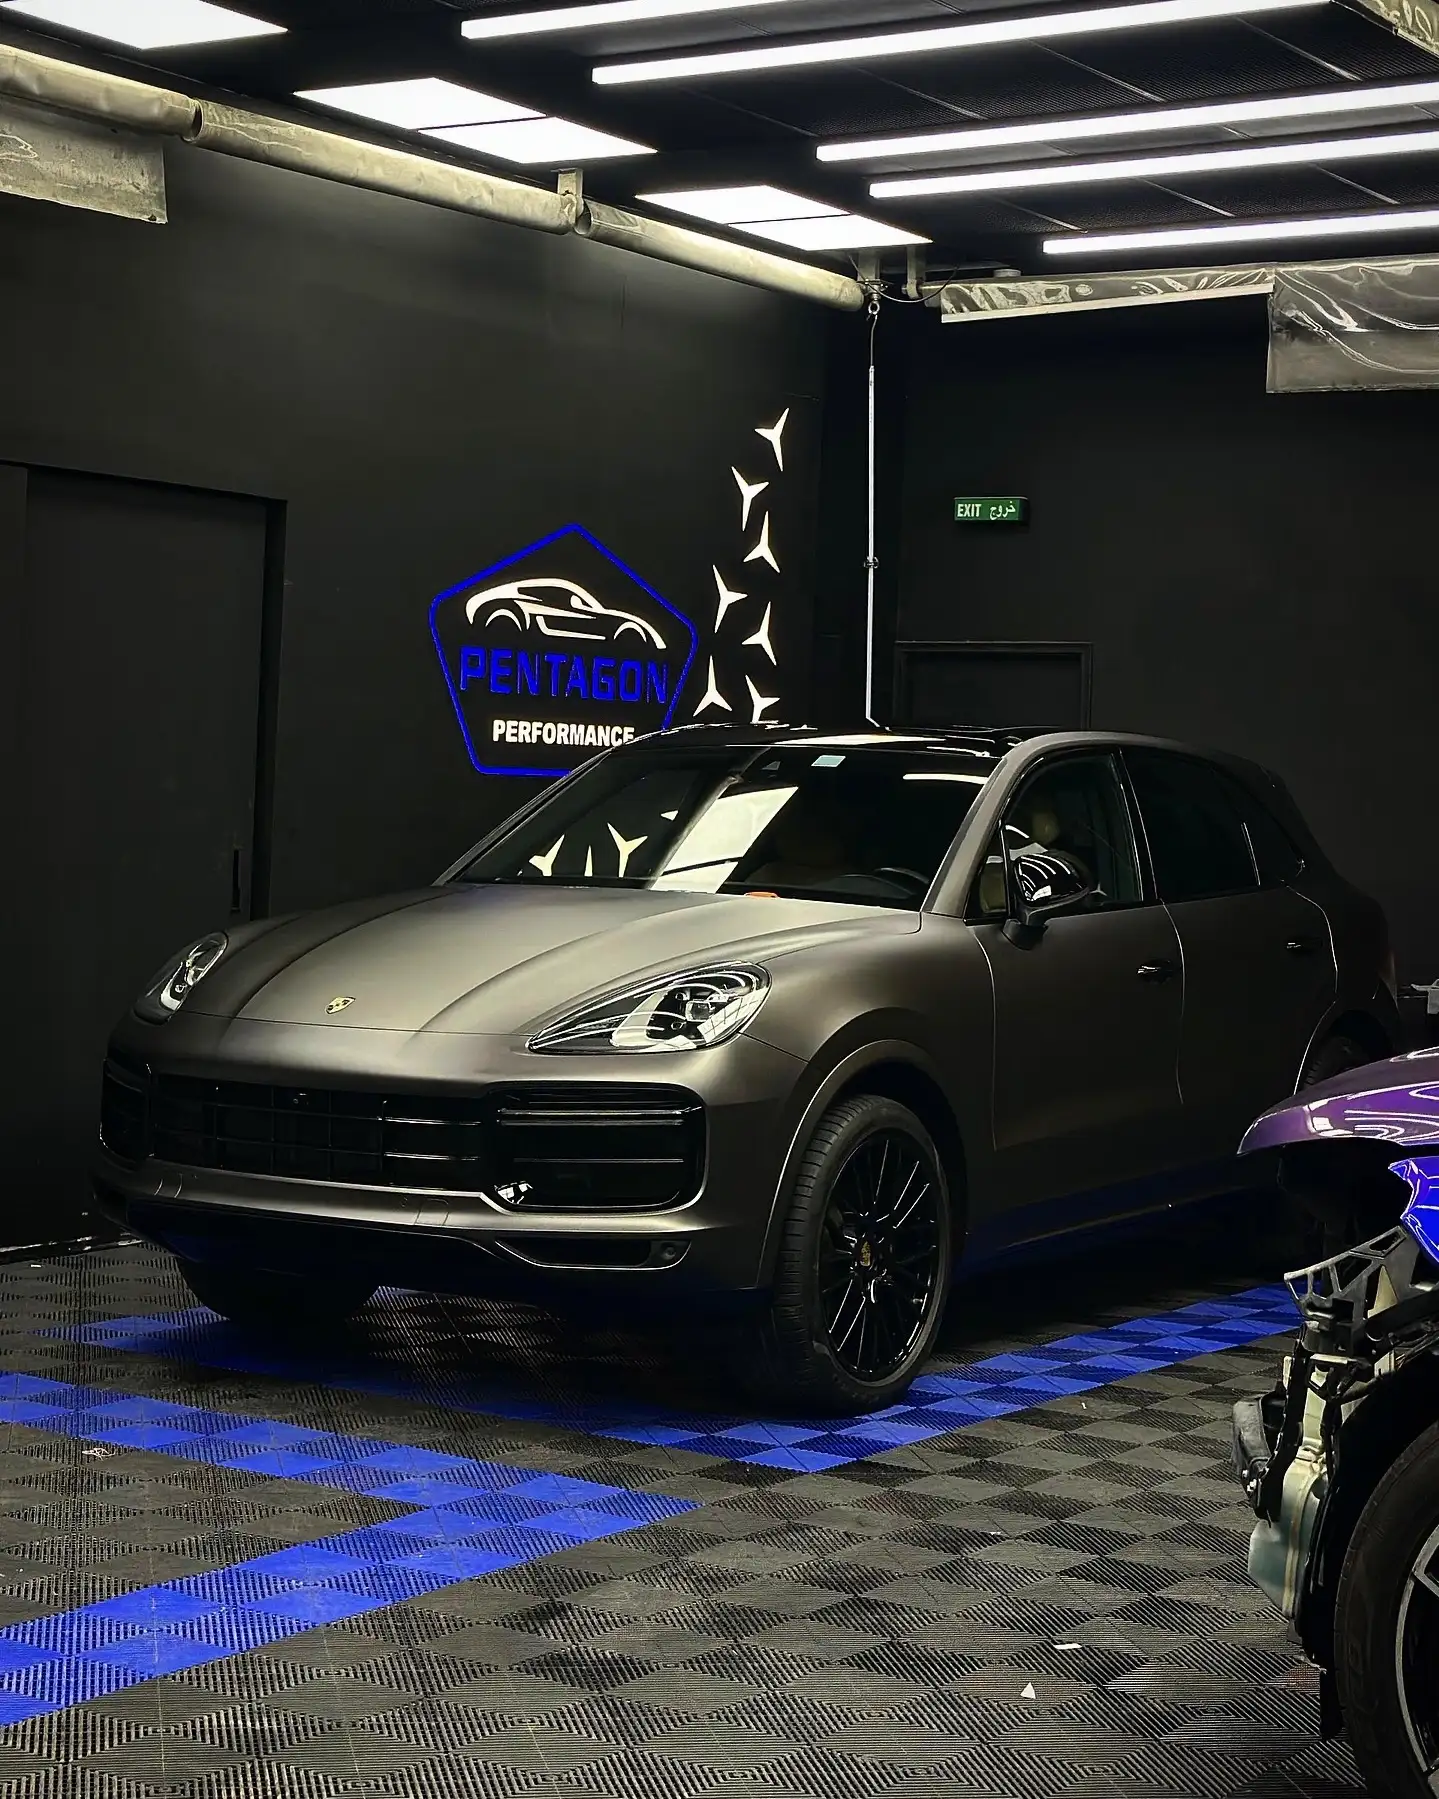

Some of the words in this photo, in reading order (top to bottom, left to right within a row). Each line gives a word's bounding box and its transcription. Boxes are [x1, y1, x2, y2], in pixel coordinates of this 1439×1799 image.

[957, 503, 982, 517] EXIT
[989, 500, 1016, 520] خروج
[460, 646, 668, 703] PENTAGON
[493, 719, 635, 747] PERFORMANCE
